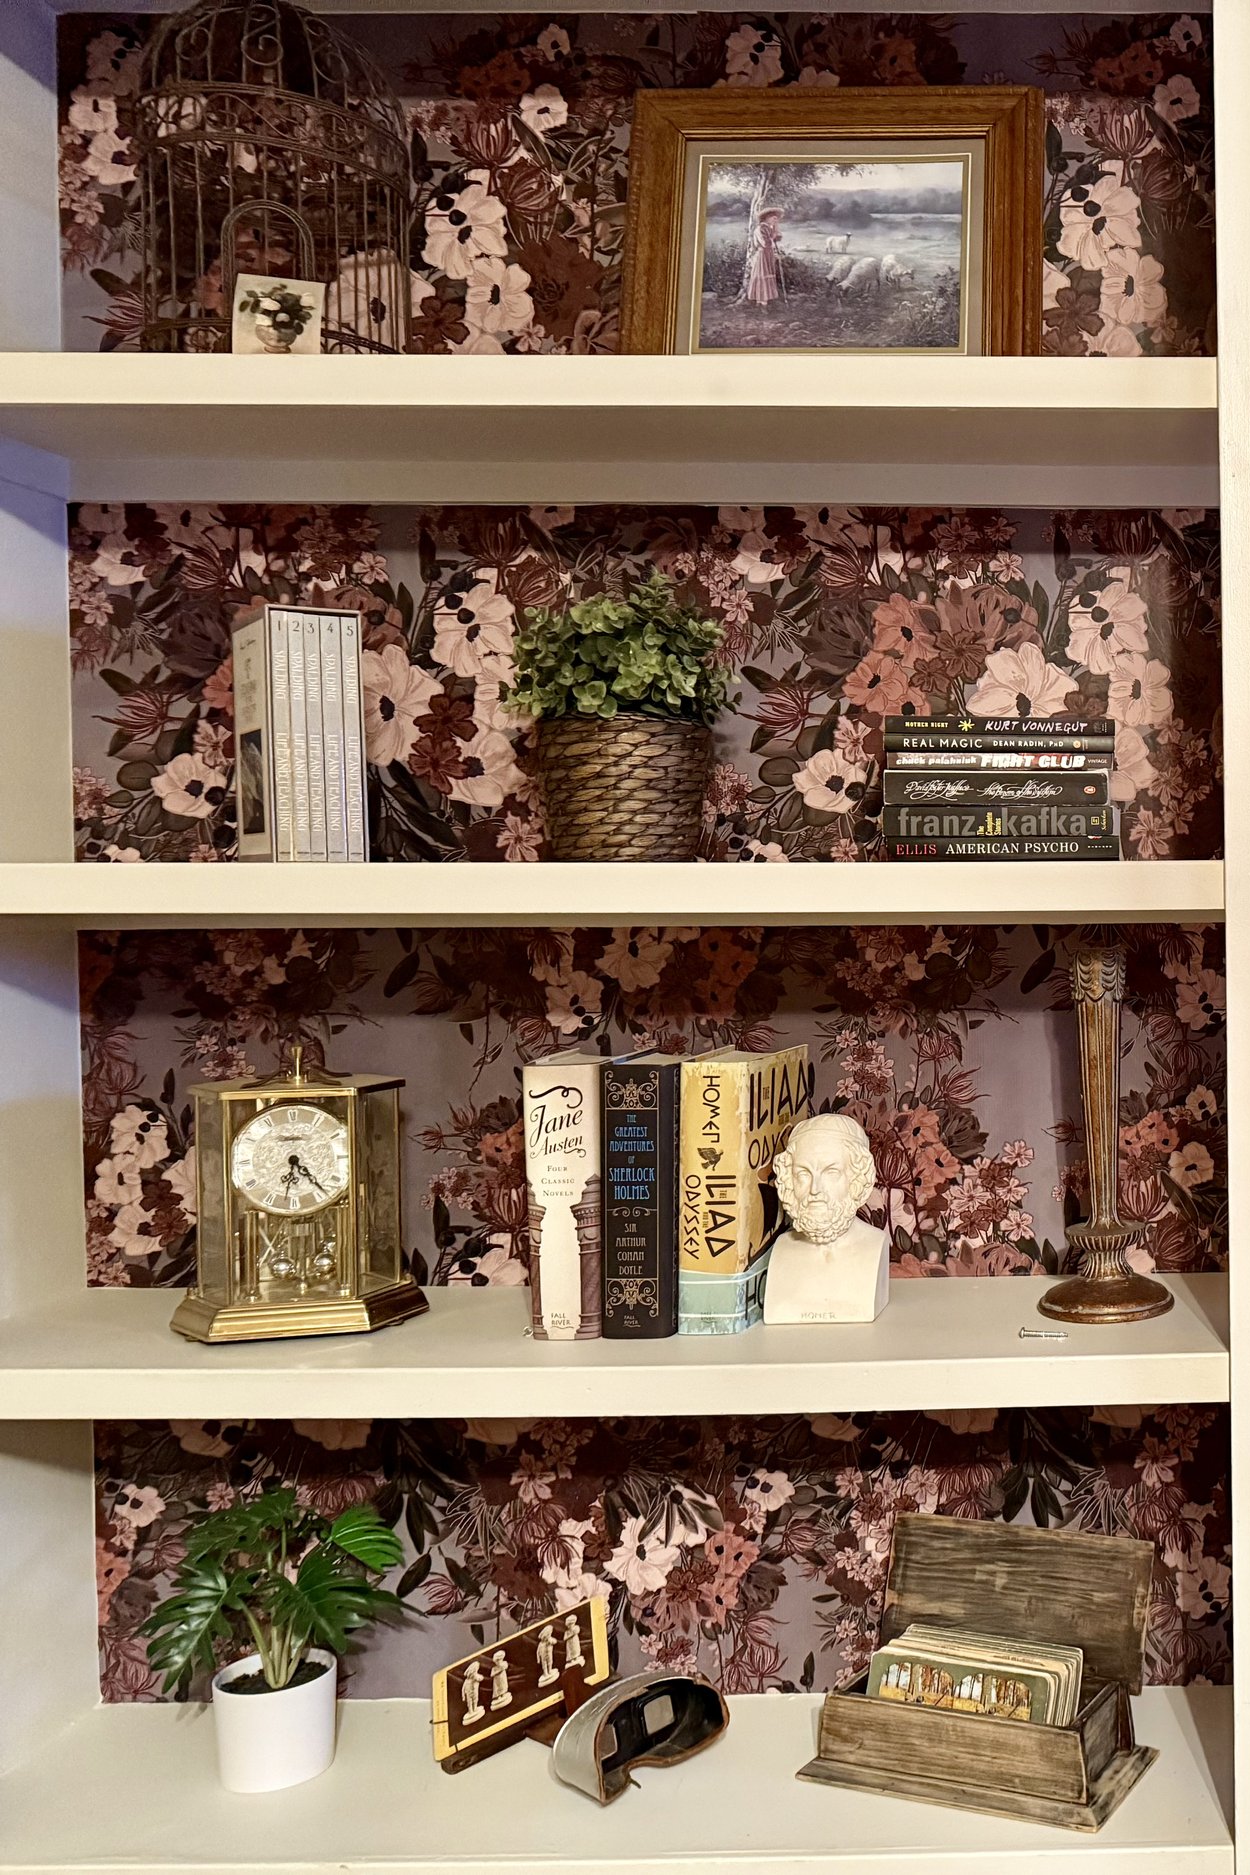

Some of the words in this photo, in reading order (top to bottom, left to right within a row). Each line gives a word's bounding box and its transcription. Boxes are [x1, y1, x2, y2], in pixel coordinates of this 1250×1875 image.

[274, 650, 287, 700] SPALDING
[291, 651, 304, 700] SPALDING
[307, 653, 320, 702] SPALDING
[325, 653, 337, 702] SPALDING
[345, 656, 357, 704] SPALDING
[903, 738, 935, 748] REAL
[940, 738, 983, 748] MAGIC
[1018, 740, 1046, 748] RADIN,
[896, 756, 926, 765] chuck
[928, 756, 977, 765] palahniuk
[980, 754, 1035, 768] FIGHT
[1038, 755, 1086, 769] CLUB
[898, 807, 976, 836] franz
[1001, 806, 1087, 836] kafka
[896, 843, 937, 855] ELLIS
[945, 842, 1019, 855] AMERICAN
[1025, 841, 1079, 853] PSYCHO
[749, 1059, 808, 1132] ILIAD
[626, 1114, 637, 1123] THE
[702, 1075, 720, 1143] HOMER
[529, 1105, 584, 1148] Jane
[614, 1126, 648, 1138] GREATEST
[529, 1135, 586, 1159] Austen
[609, 1140, 655, 1152] ADVENTURES
[608, 1167, 655, 1182] SHERLOCK
[614, 1185, 650, 1200] HOLMES
[684, 1174, 701, 1260] ODYSSEY
[705, 1175, 736, 1258] ILIAD
[624, 1223, 637, 1233] SIR
[615, 1237, 646, 1247] ARTHUR
[617, 1251, 645, 1261] CONAN
[619, 1265, 643, 1275] DOYLE
